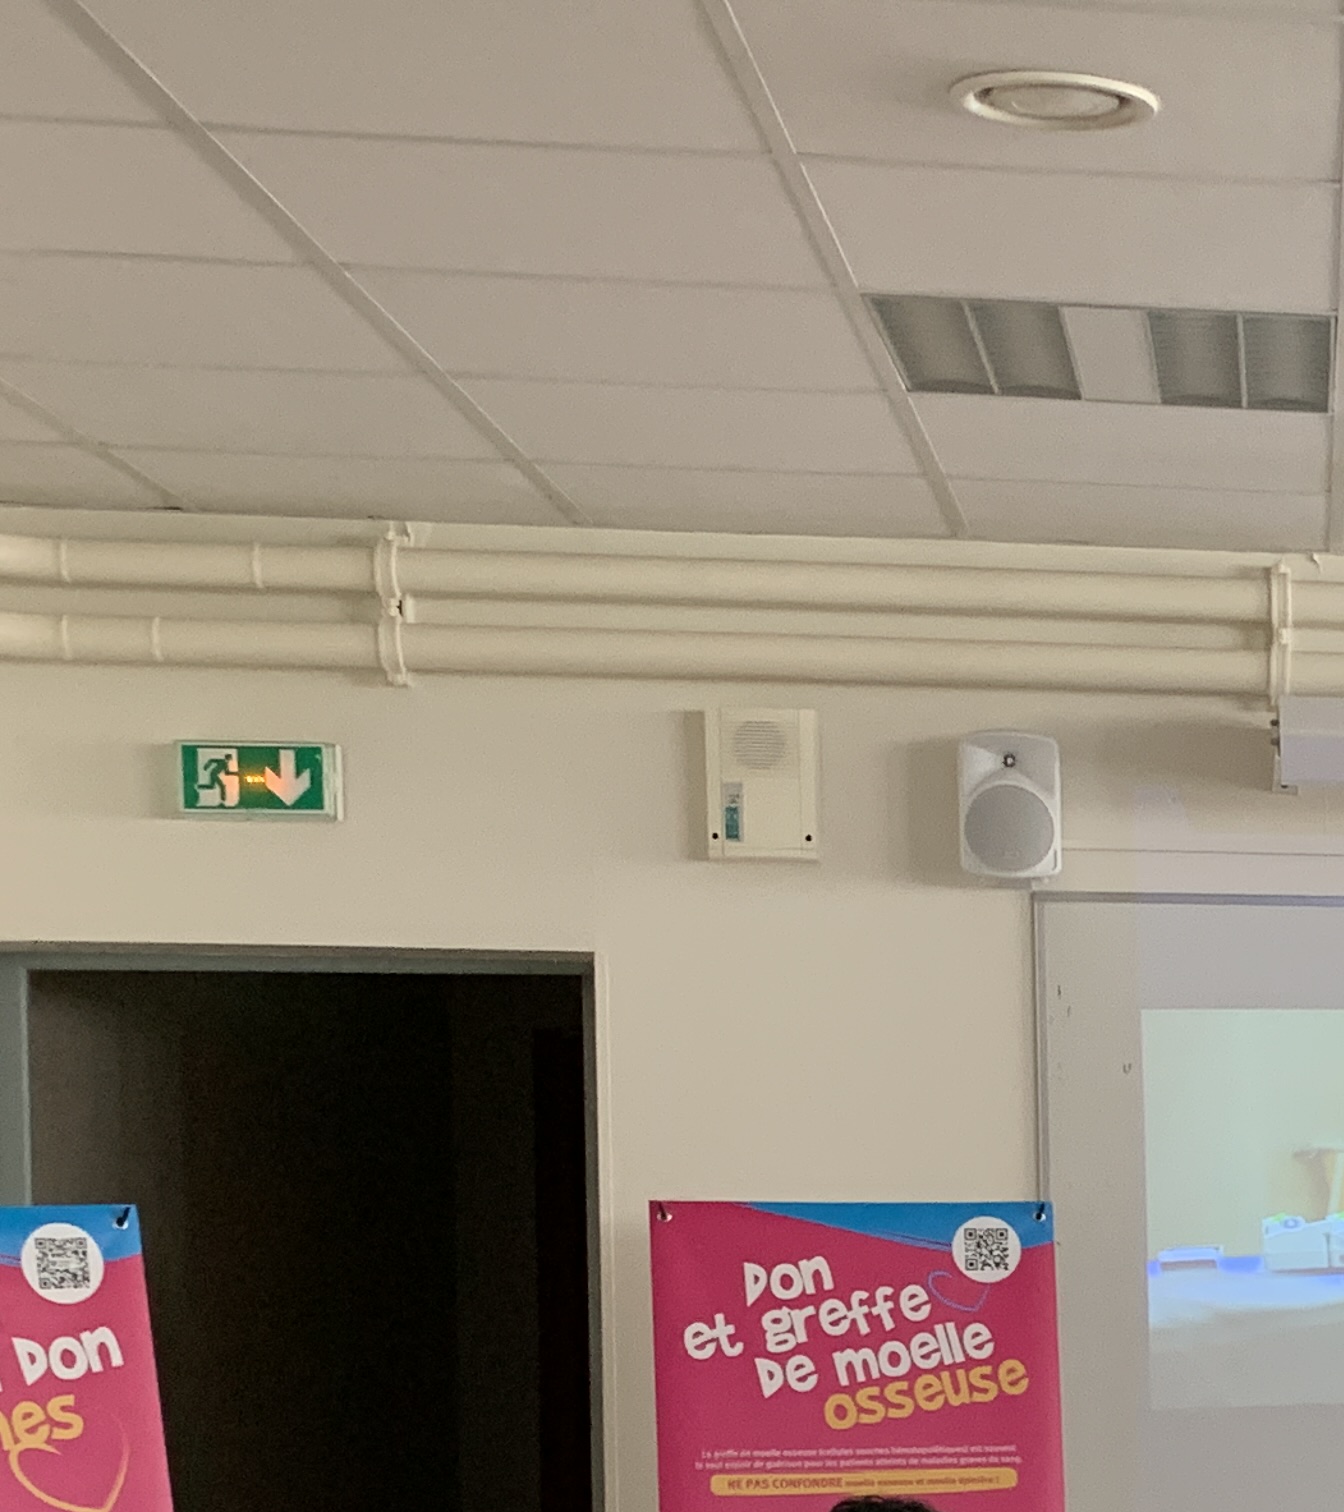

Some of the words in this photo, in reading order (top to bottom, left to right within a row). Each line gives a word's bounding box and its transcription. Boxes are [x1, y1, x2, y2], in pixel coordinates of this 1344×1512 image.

[743, 1256, 834, 1307] Don
[684, 1313, 744, 1360] et
[761, 1284, 931, 1354] greffe
[832, 1322, 994, 1386] moelle
[824, 1359, 1029, 1430] osseuse
[746, 1479, 769, 1490] PAS
